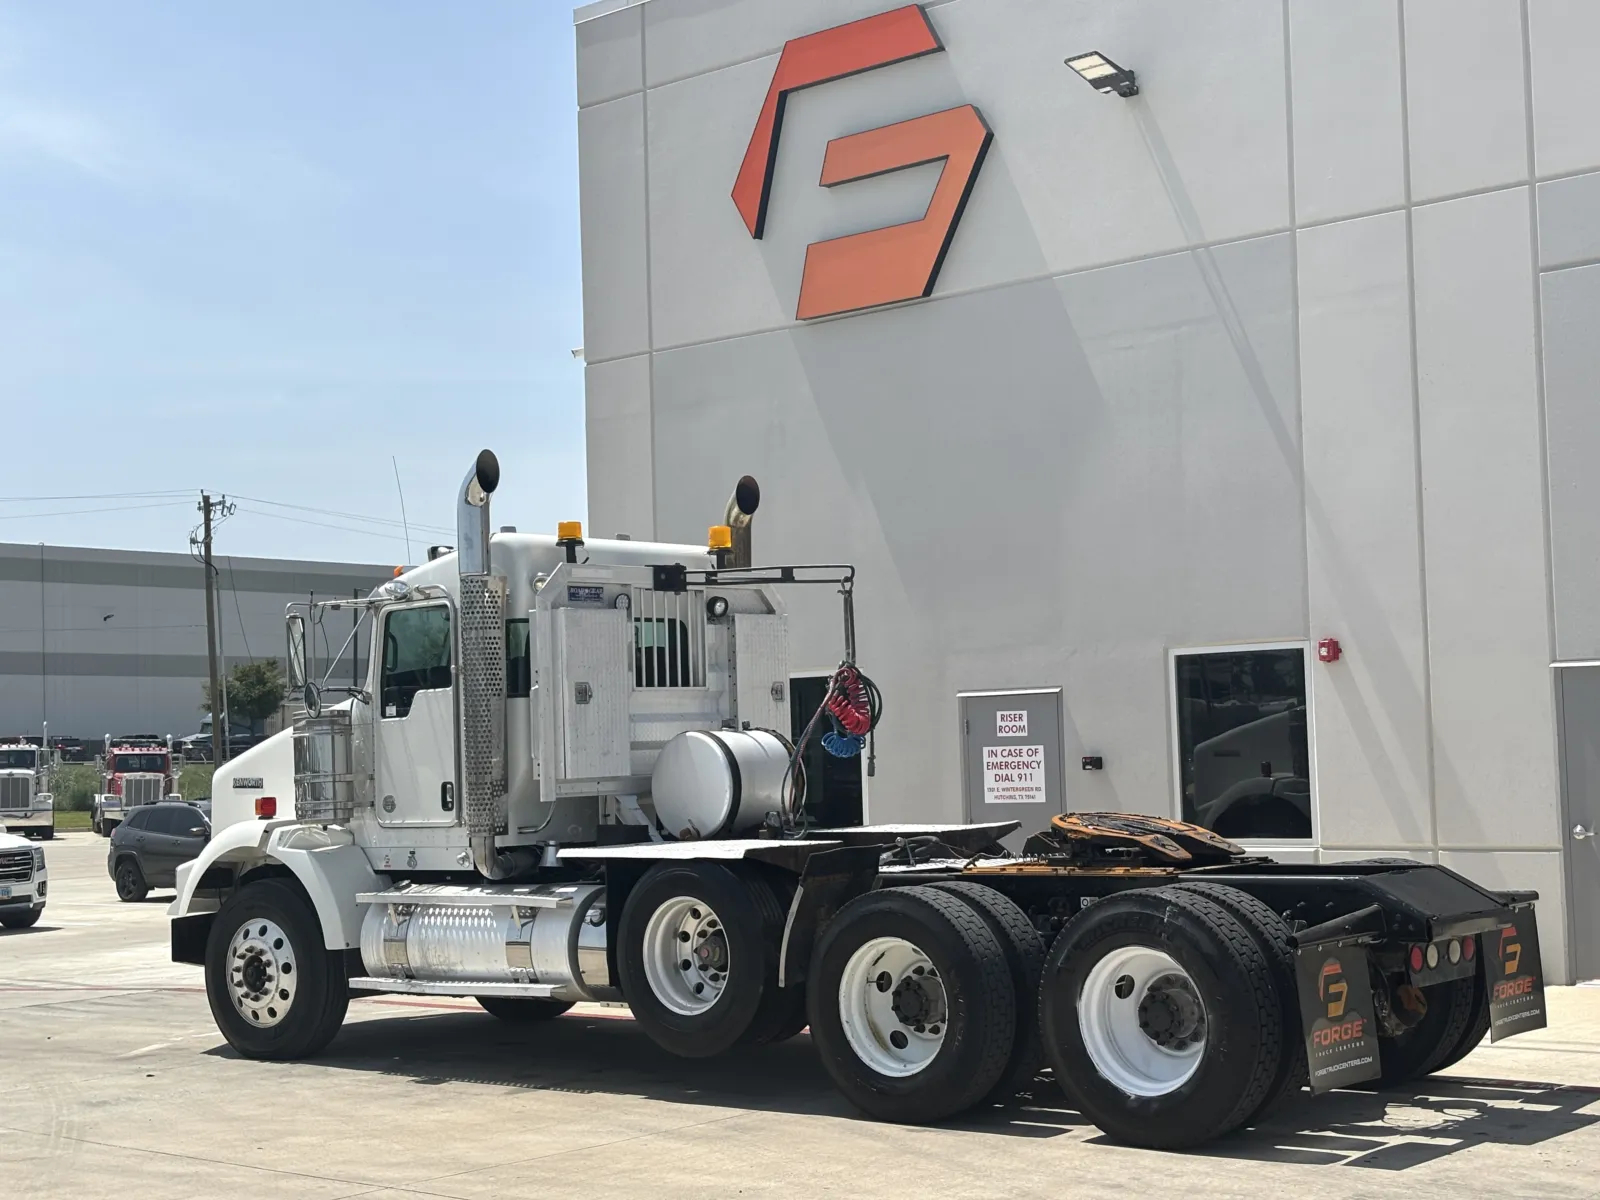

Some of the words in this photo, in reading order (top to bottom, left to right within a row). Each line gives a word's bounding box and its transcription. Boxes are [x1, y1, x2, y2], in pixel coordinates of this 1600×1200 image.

[1000, 713, 1024, 722] RISER
[998, 725, 1026, 734] ROOM
[987, 749, 998, 758] IN
[1000, 748, 1023, 758] CASE
[1026, 748, 1039, 757] OF
[986, 760, 1042, 770] EMERGENCY
[994, 773, 1016, 782] DIAL
[1017, 773, 1033, 782] 911
[1493, 976, 1533, 1002] FORGE
[1312, 1019, 1364, 1048] FORGE
